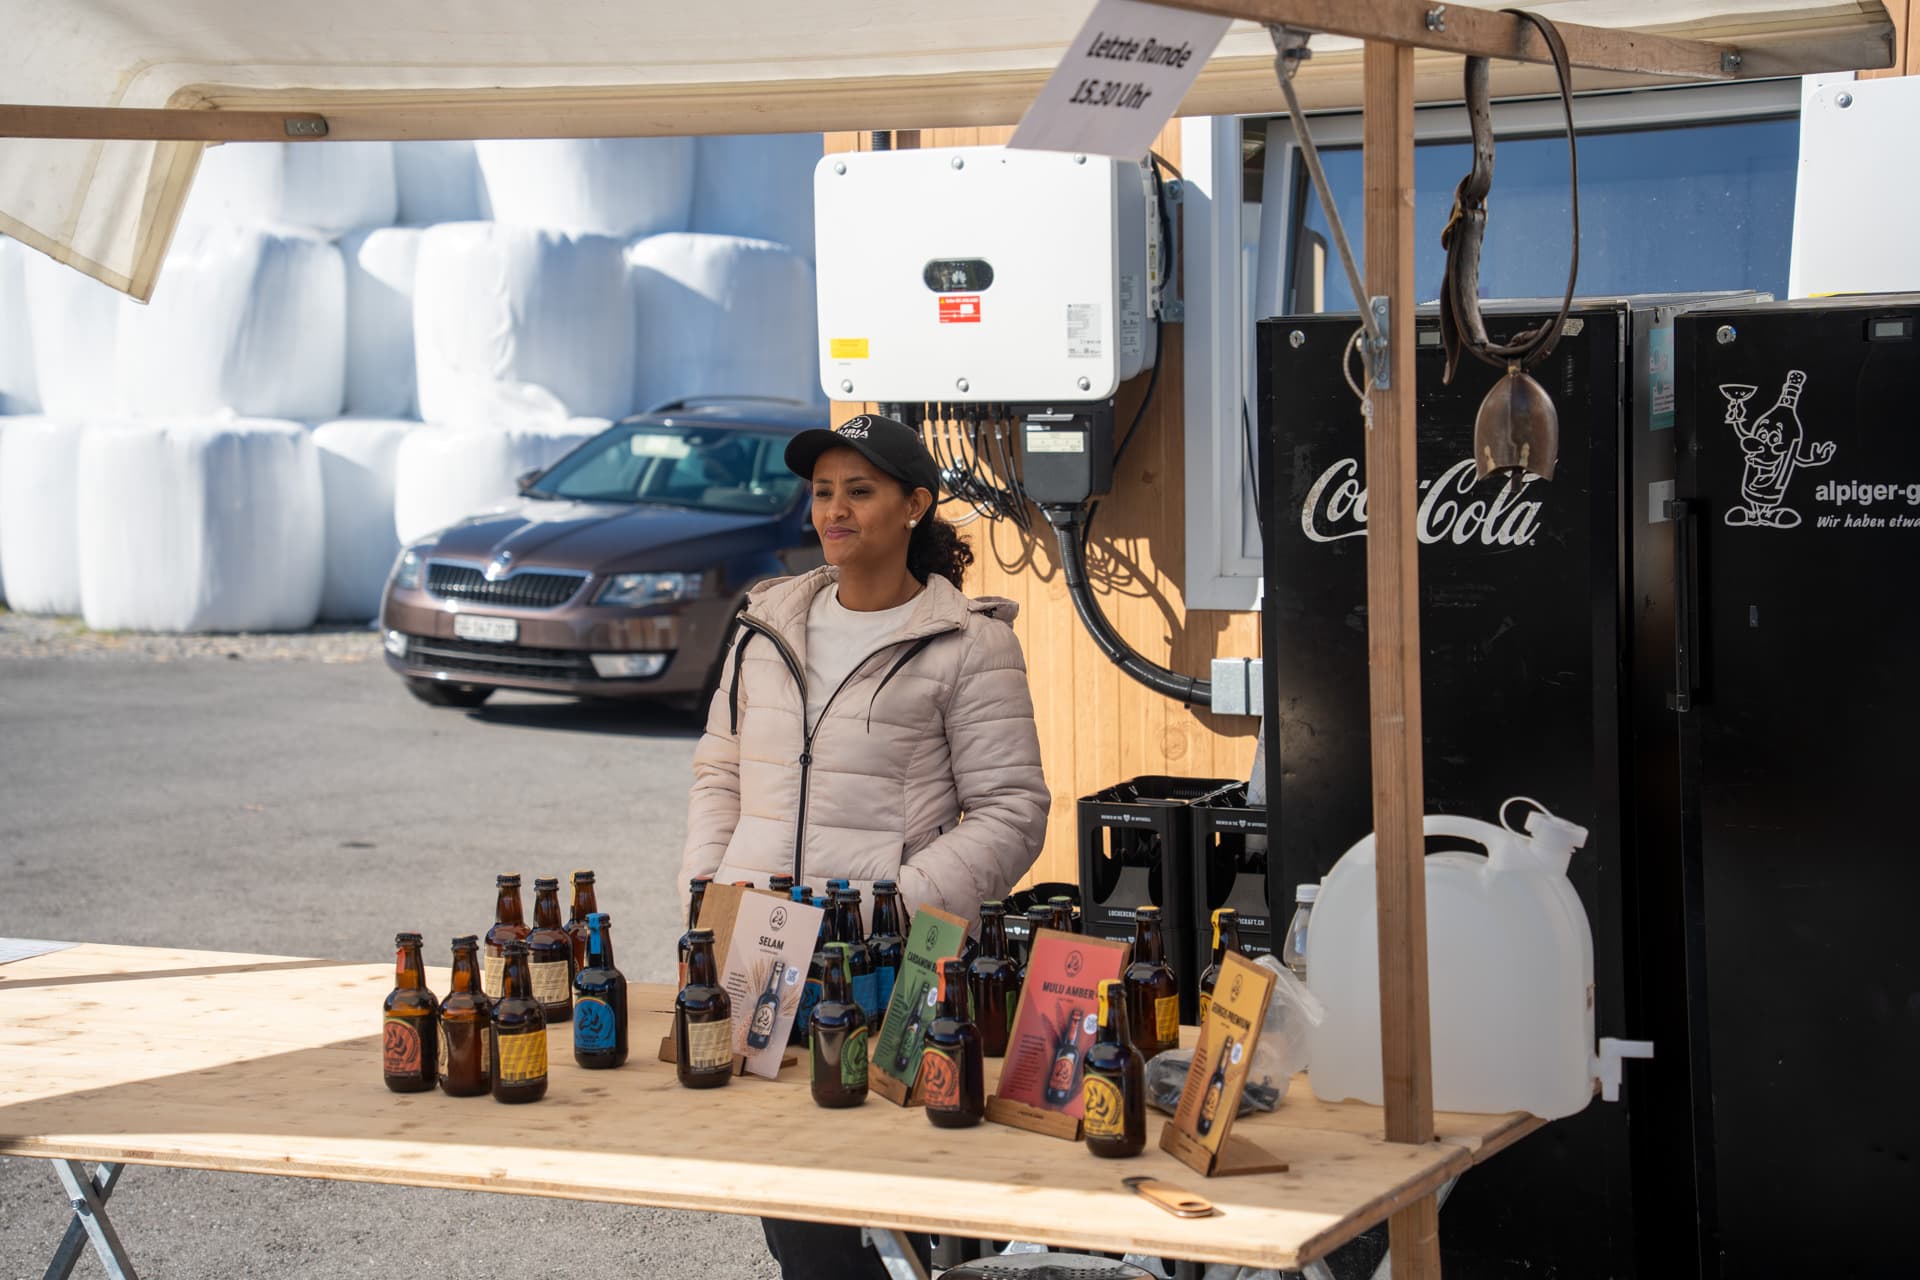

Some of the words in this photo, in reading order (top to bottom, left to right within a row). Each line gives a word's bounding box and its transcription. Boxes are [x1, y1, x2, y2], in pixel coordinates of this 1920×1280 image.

[1086, 32, 1138, 62] Letzte
[1137, 38, 1192, 69] Runde
[1069, 79, 1119, 107] 15.30
[1117, 82, 1152, 110] Uhr
[1301, 457, 1543, 546] Coc-Cola
[1815, 480, 1920, 506] alpiger-g
[1816, 514, 1841, 528] Wir
[1843, 513, 1885, 528] haben
[758, 935, 785, 951] SELAM
[1042, 981, 1065, 995] MULU
[1065, 985, 1095, 1001] AMBER
